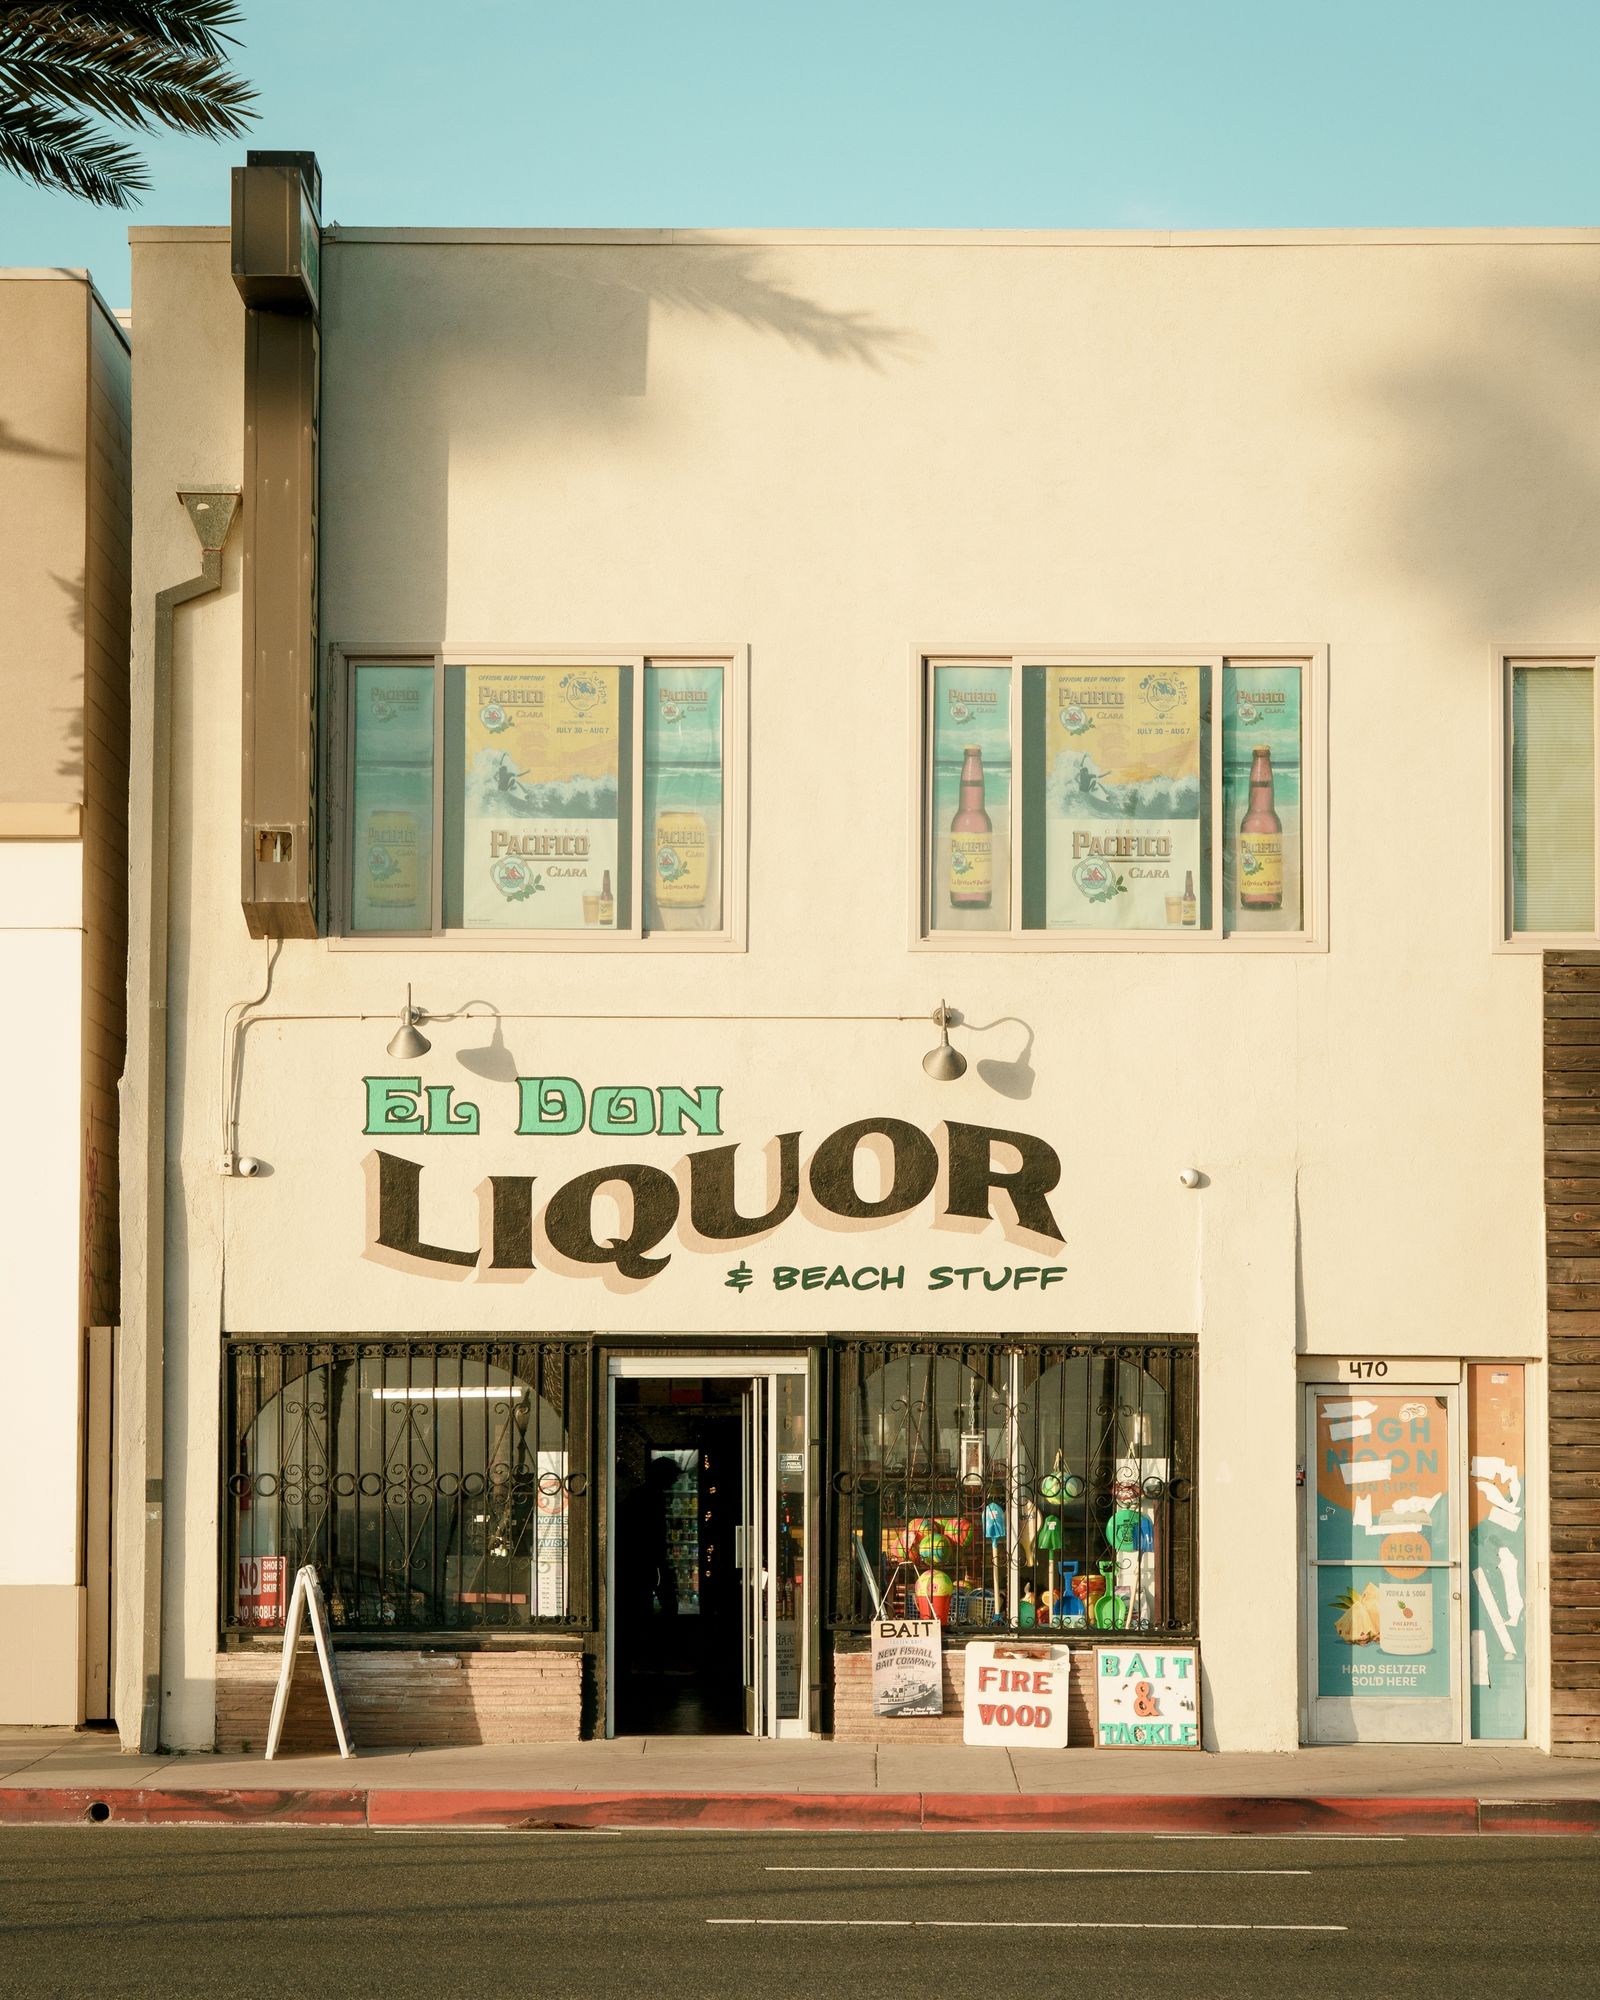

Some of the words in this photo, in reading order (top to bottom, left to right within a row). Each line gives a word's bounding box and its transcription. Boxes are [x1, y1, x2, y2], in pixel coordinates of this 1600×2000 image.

[478, 686, 545, 705] PACIFICO
[1058, 688, 1125, 707] PACIFICO
[516, 710, 544, 718] CLARA
[1096, 711, 1125, 720] CLARA
[490, 830, 590, 858] PACIFICO
[1072, 831, 1172, 859] PACIFICO
[546, 866, 588, 878] CLARA
[1128, 867, 1170, 878] CLARA
[370, 1116, 1068, 1283] LIQUOR
[725, 1261, 753, 1294] &
[772, 1266, 906, 1292] BEACH
[928, 1266, 1068, 1292] STUFF
[1349, 1361, 1389, 1379] 470
[1391, 1544, 1422, 1553] HIGH
[240, 1563, 258, 1589] NO
[881, 1622, 933, 1638] BAIT
[878, 1647, 898, 1660] NEW
[876, 1658, 894, 1671] BAIT
[896, 1657, 936, 1669] COMPANY
[1101, 1653, 1193, 1679] BAIT
[1342, 1665, 1376, 1674] HARD
[1378, 1665, 1426, 1674] SELTZER
[978, 1666, 1053, 1694] FIRE
[1352, 1677, 1383, 1686] SOLD
[1386, 1677, 1417, 1686] HERE
[1134, 1681, 1157, 1717] &
[978, 1703, 1051, 1728] WOOD
[1099, 1723, 1198, 1746] TACKLE
